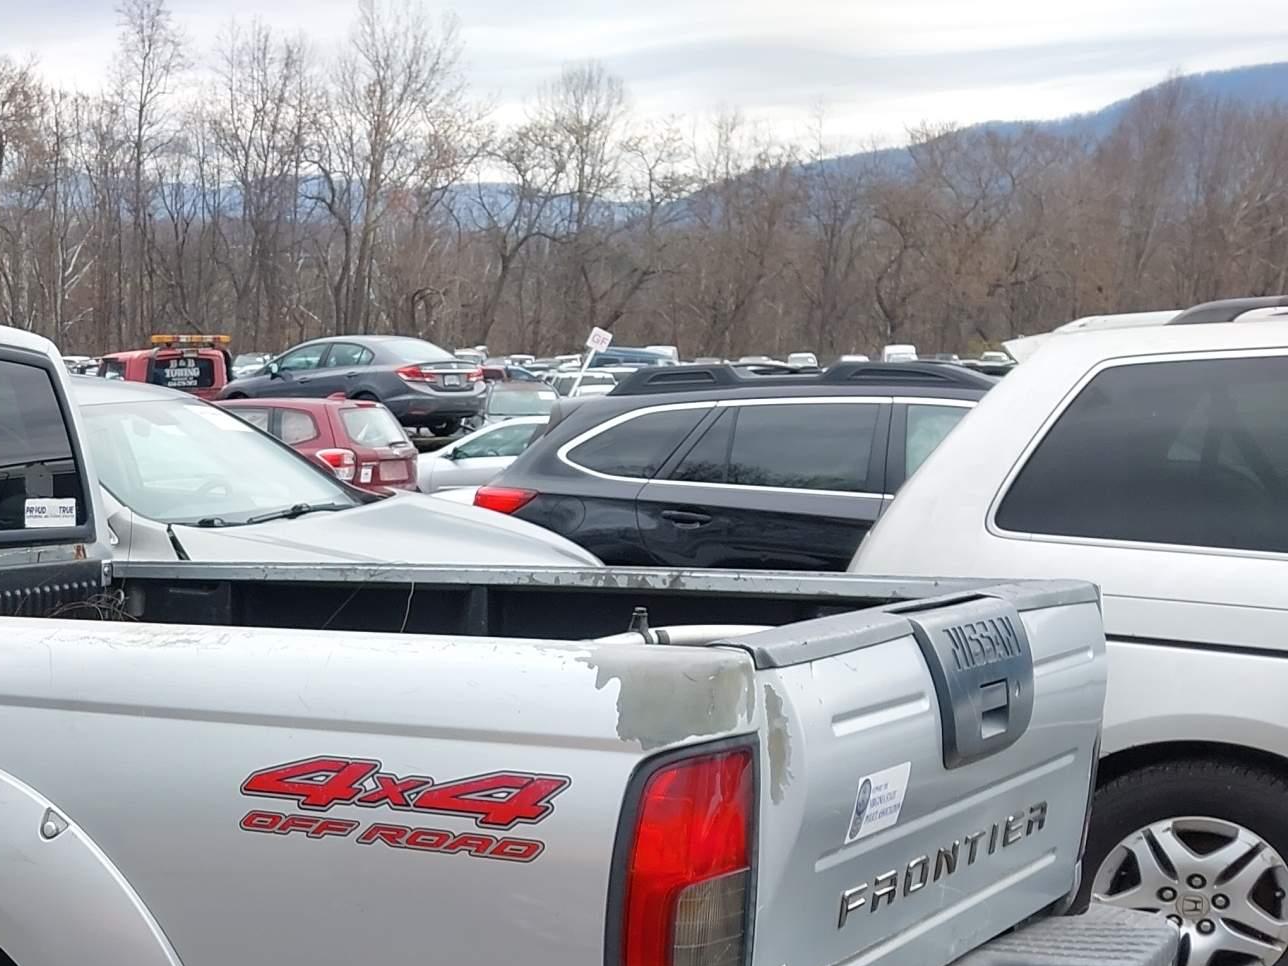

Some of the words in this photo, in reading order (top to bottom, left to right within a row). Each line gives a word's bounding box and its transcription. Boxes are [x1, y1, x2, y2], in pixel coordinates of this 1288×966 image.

[164, 368, 200, 377] TOWING
[58, 505, 74, 514] TRUE
[942, 616, 1022, 672] NISSAN
[240, 754, 572, 830] 4x4
[239, 809, 360, 840] OFF
[355, 823, 546, 864] ROAD
[837, 799, 1048, 929] FRONTIER
